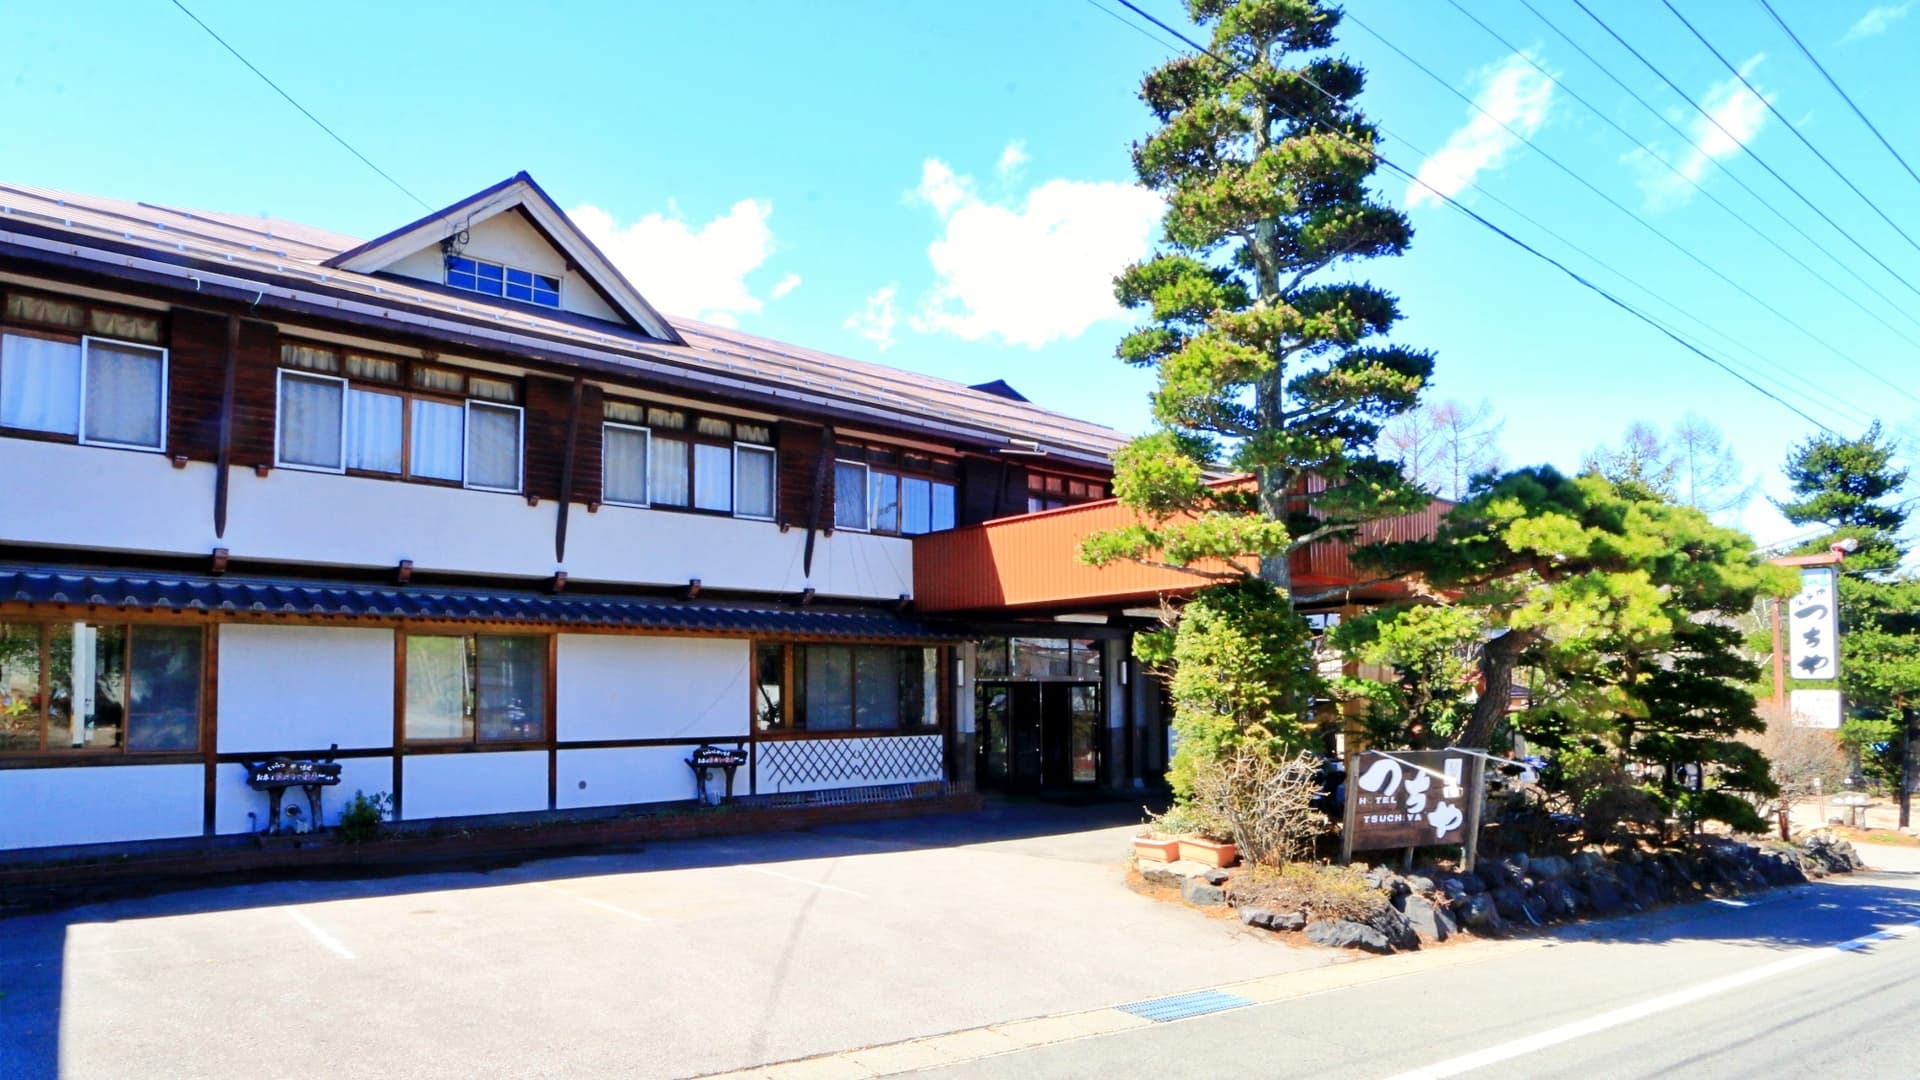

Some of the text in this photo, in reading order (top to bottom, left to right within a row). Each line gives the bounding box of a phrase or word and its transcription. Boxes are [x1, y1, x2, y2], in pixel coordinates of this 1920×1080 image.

[1795, 605, 1829, 675] つちや
[1359, 759, 1463, 839] つちや
[1359, 796, 1398, 806] HTEL
[1363, 814, 1422, 824] TSUCHYA
